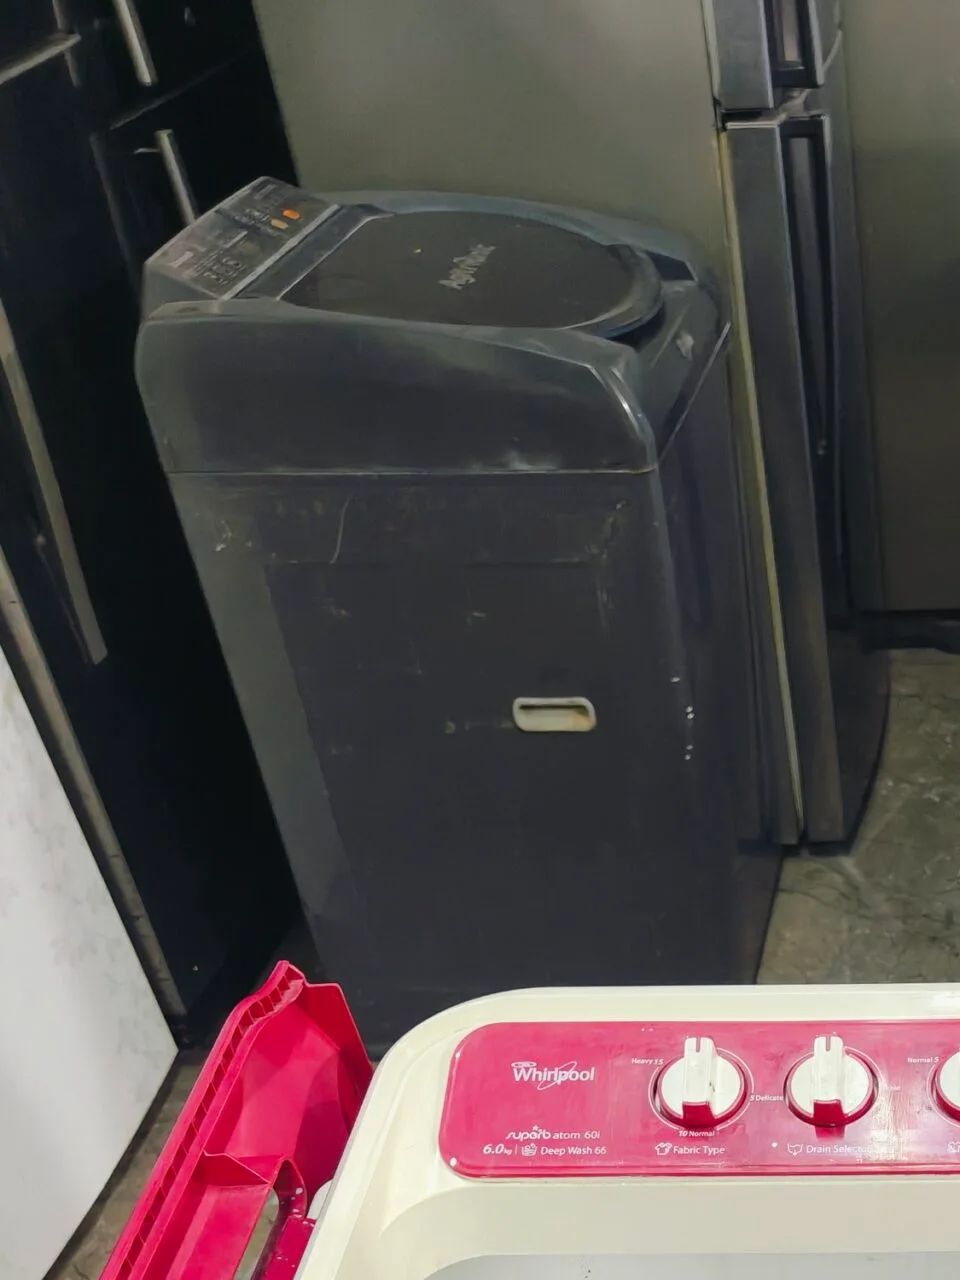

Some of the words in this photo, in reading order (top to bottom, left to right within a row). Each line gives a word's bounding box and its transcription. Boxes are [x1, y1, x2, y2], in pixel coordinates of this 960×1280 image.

[631, 1057, 653, 1066] Heavy
[907, 1056, 933, 1064] Normal
[511, 1063, 596, 1087] Whirlpool
[552, 1130, 581, 1140] atom
[688, 1130, 716, 1138] Normal
[540, 1145, 566, 1157] Deep
[566, 1145, 593, 1156] Wash
[594, 1146, 607, 1156] 66
[673, 1144, 702, 1155] Fabric
[702, 1144, 726, 1157] Type
[806, 1144, 831, 1154] Drain
